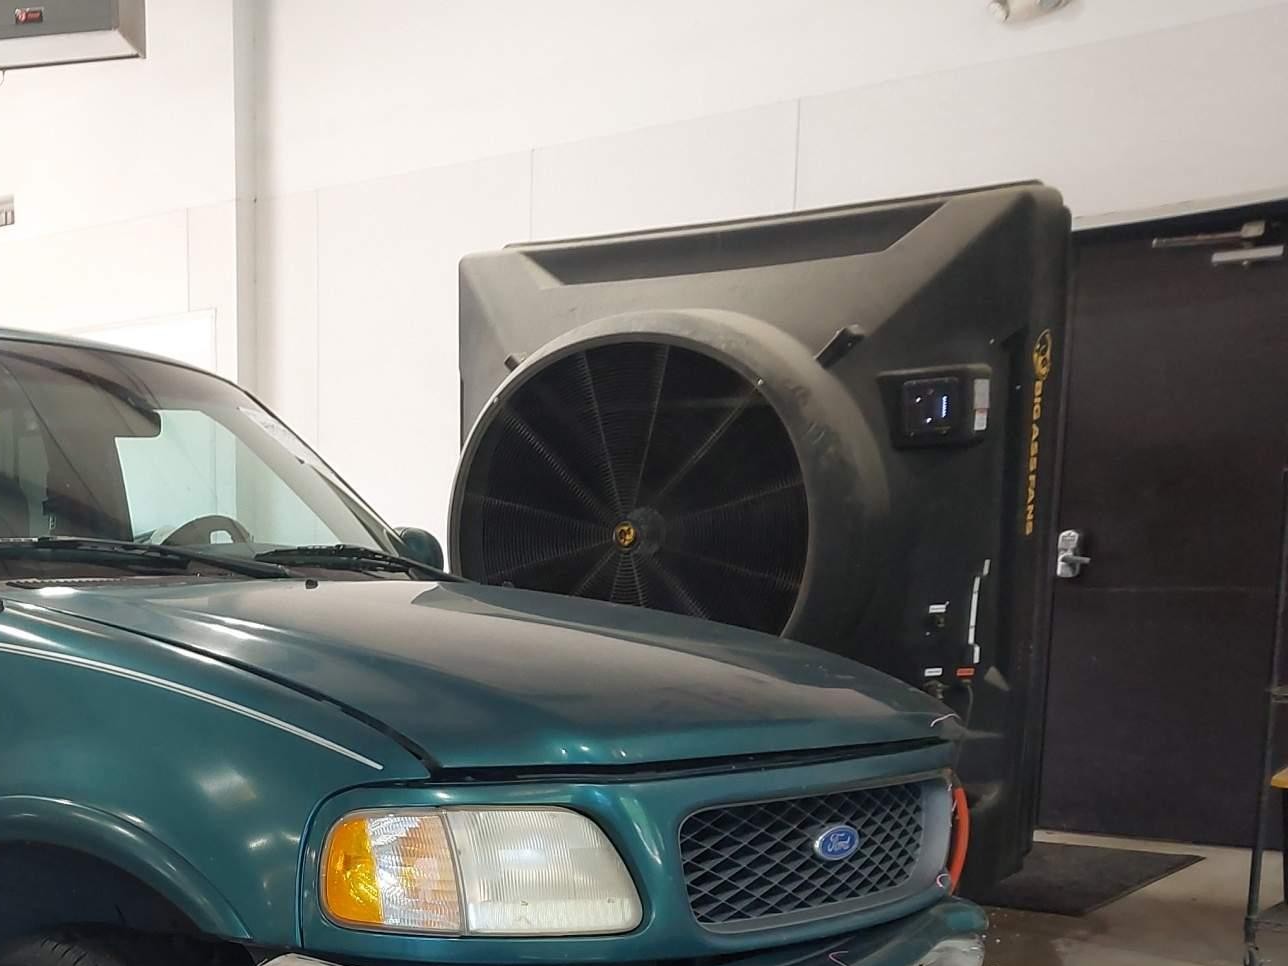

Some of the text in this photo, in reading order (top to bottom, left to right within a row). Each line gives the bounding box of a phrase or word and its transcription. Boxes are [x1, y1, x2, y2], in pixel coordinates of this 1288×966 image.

[1025, 380, 1044, 536] BIG ASS FANS
[827, 832, 852, 853] Ford
